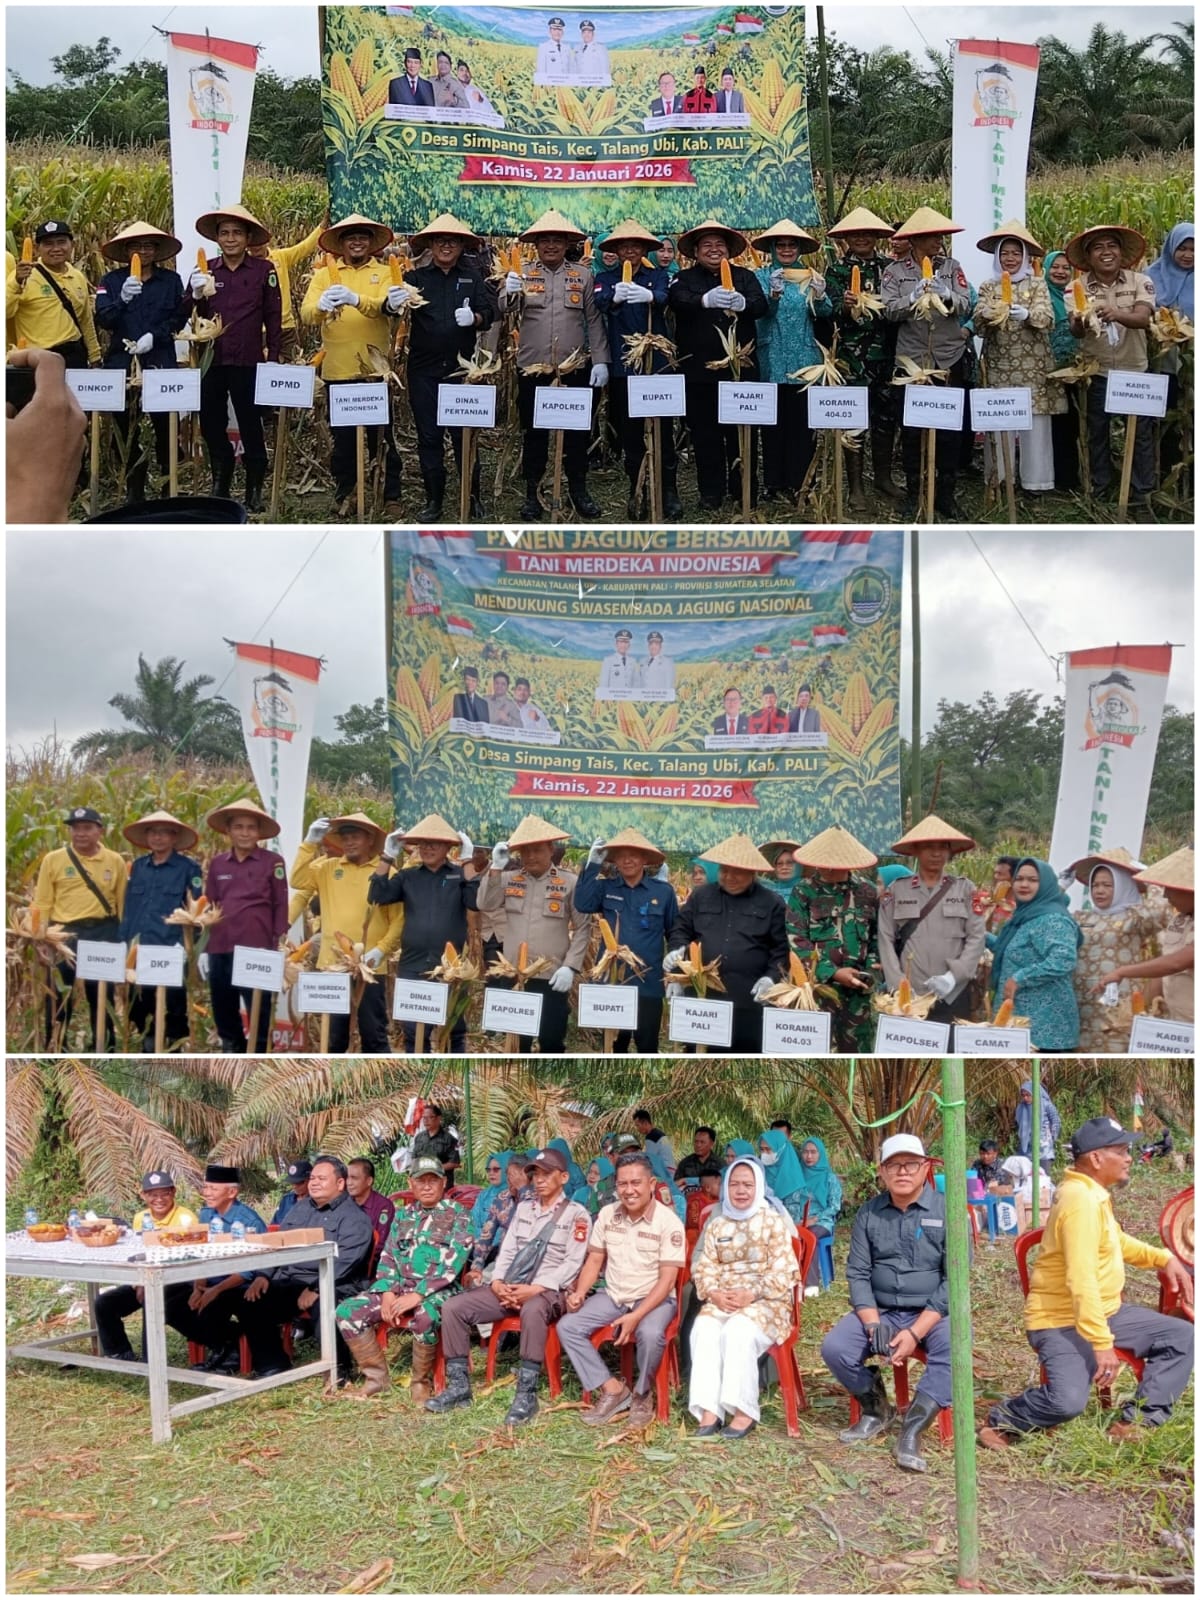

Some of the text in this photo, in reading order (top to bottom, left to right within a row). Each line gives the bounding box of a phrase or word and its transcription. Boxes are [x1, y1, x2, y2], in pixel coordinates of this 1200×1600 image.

[421, 131, 744, 156] Desa Simpang Tais, Kec. Talang Ubi, Kab. PALI
[482, 160, 673, 181] Kamis, 22 Januari 2026
[77, 385, 114, 393] DINKOP
[160, 384, 184, 394] DKP
[270, 380, 300, 390] DPMD
[1125, 382, 1151, 390] KADES
[642, 394, 672, 402] BUPATI
[733, 392, 764, 400] KAJARI
[1111, 391, 1145, 400] SIMPANG
[455, 398, 479, 406] DINAS
[542, 402, 585, 411] KAPOLRES
[819, 400, 858, 408] KORAMIL
[911, 401, 957, 411] KAPOLSEK
[987, 399, 1015, 407] CAMAT
[444, 408, 489, 416] PERTANIAN
[739, 404, 757, 412] PALI
[976, 409, 1027, 418] TALANG UBI
[572, 531, 667, 549] JAGUNG
[676, 531, 791, 548] BERSAMA
[518, 555, 761, 574] TANI MERDEKA INDONESIA
[498, 577, 547, 588] KECAMATAN
[603, 583, 649, 592] KABUPATEN
[651, 582, 668, 591] PALI
[675, 581, 712, 590] PROVINSI
[714, 579, 757, 589] SUMATERA
[760, 578, 795, 588] SELATAN
[474, 593, 813, 616] MENDUKUNG SWASEMBADA JAGUNG NASIONAL
[478, 747, 817, 774] Desa Simpang Tais, Kec. Talang Ubi, Kab. PALI
[533, 777, 733, 798] Kamis, 22 Januari 2026
[150, 960, 170, 969] DKP
[245, 962, 272, 973] DPMD
[409, 992, 432, 1001] DINAS
[399, 1003, 441, 1014] PERTANIAN
[491, 1004, 535, 1017] KAPOLRES
[592, 1004, 624, 1013] BUPATI
[685, 1009, 718, 1018] KAJARI
[691, 1021, 711, 1030] PALI
[775, 1022, 818, 1034] KORAMIL
[781, 1036, 812, 1047] 404.03
[885, 1033, 939, 1048] KAPOLSEK
[1155, 1031, 1190, 1044] KADES
[974, 1039, 1010, 1049] CAMAT
[1136, 1041, 1182, 1054] SIMPANG
